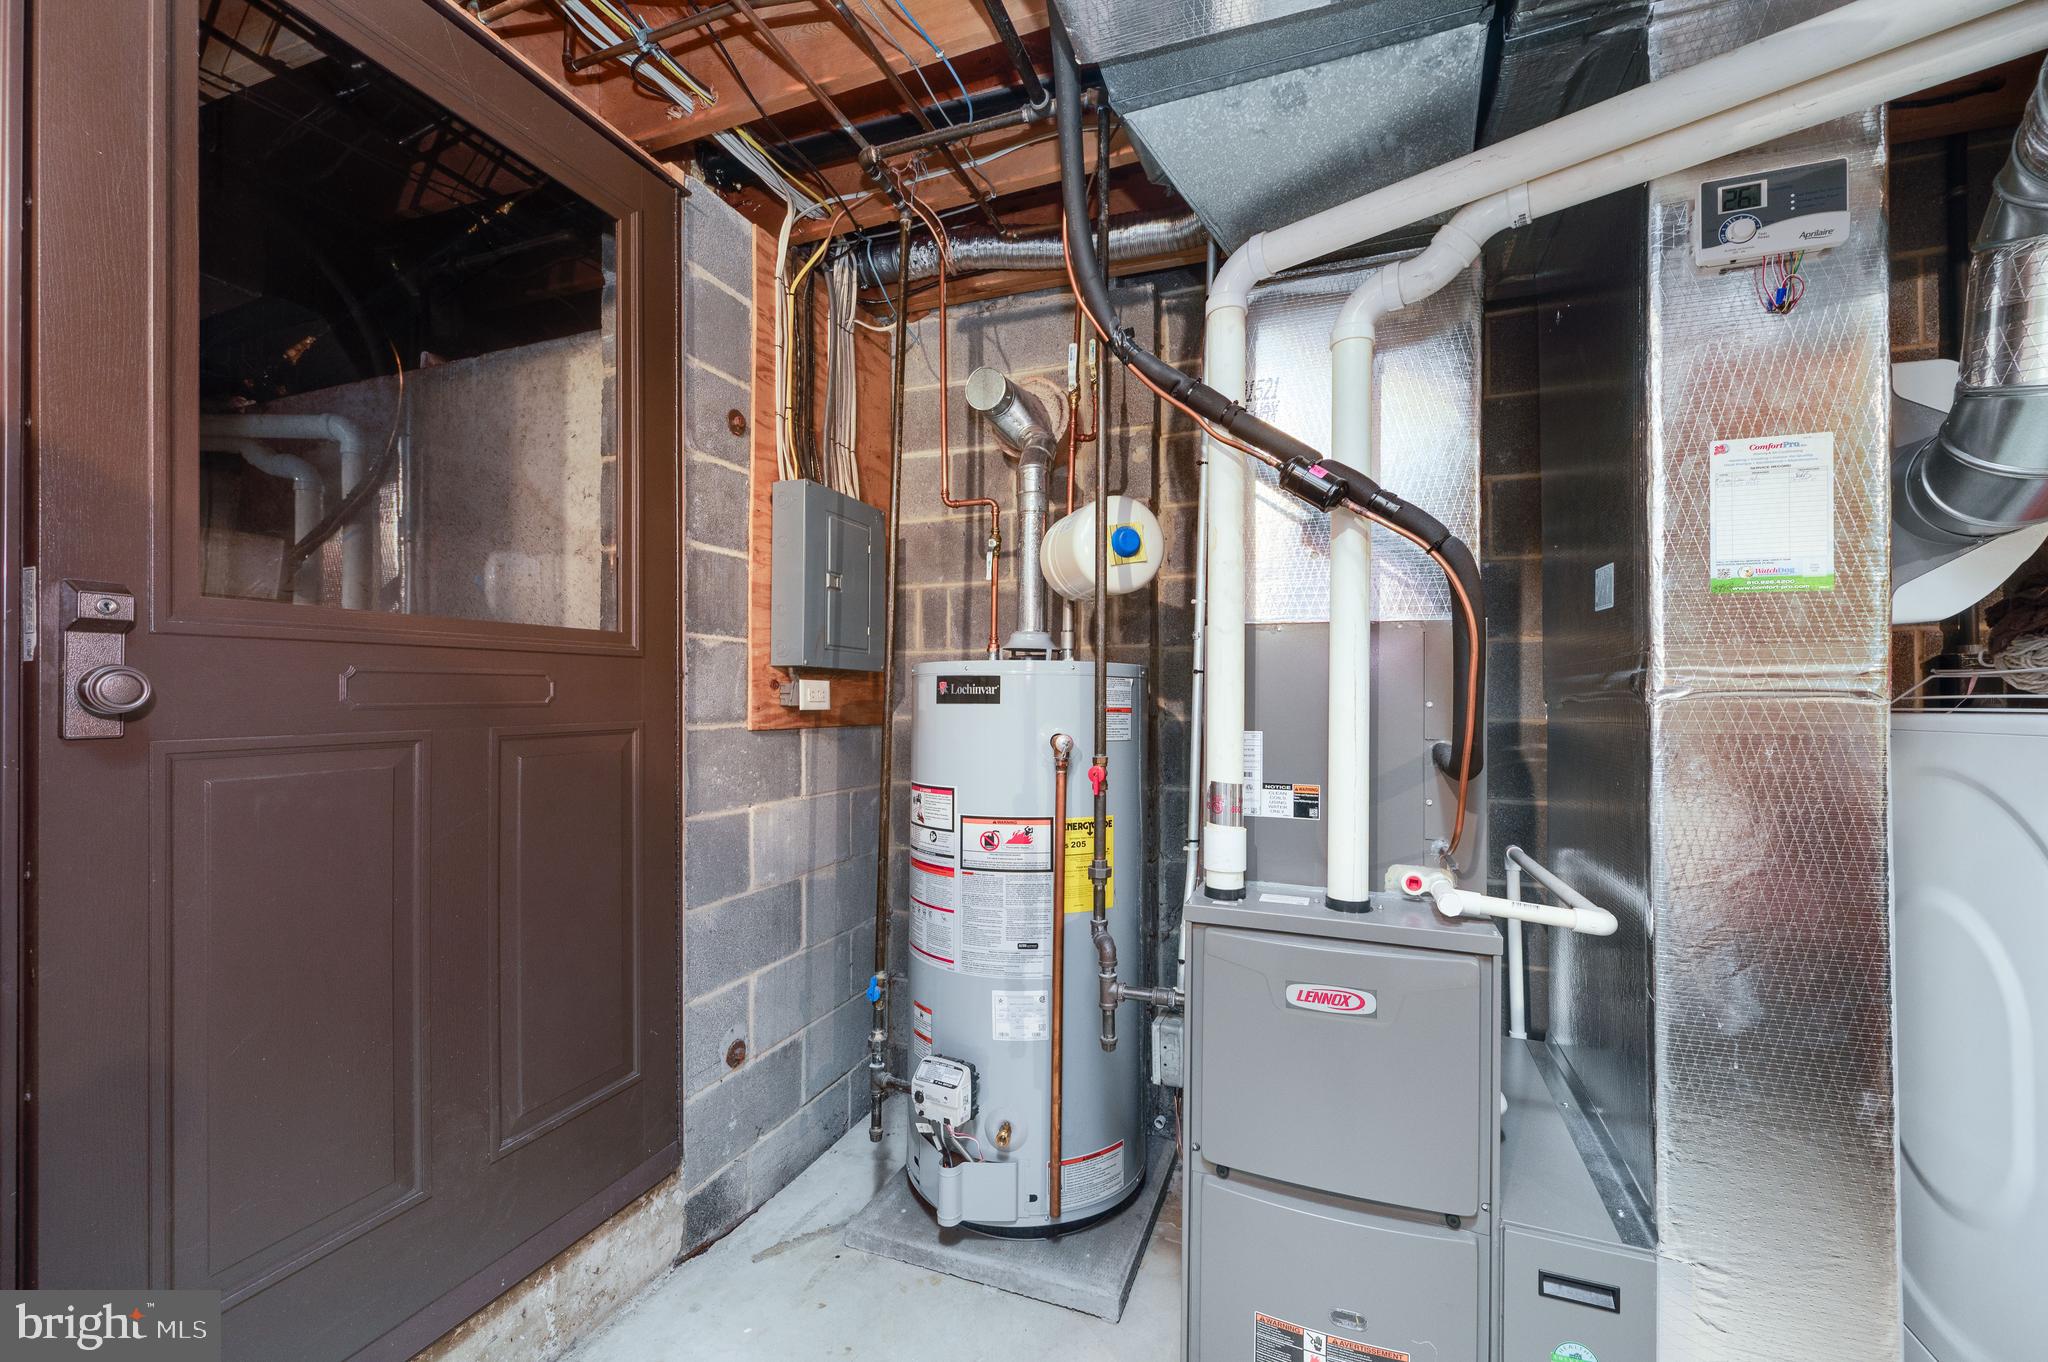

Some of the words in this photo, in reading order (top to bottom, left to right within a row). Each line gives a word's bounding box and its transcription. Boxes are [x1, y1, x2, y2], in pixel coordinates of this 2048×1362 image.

[1799, 228, 1834, 240] Aprilaire
[951, 684, 998, 695] Lochinvar
[1070, 840, 1087, 848] 205
[1296, 990, 1352, 1007] LENNOX
[1265, 1319, 1301, 1334] WARNING
[1339, 1340, 1403, 1360] AVERTISSEMENT
